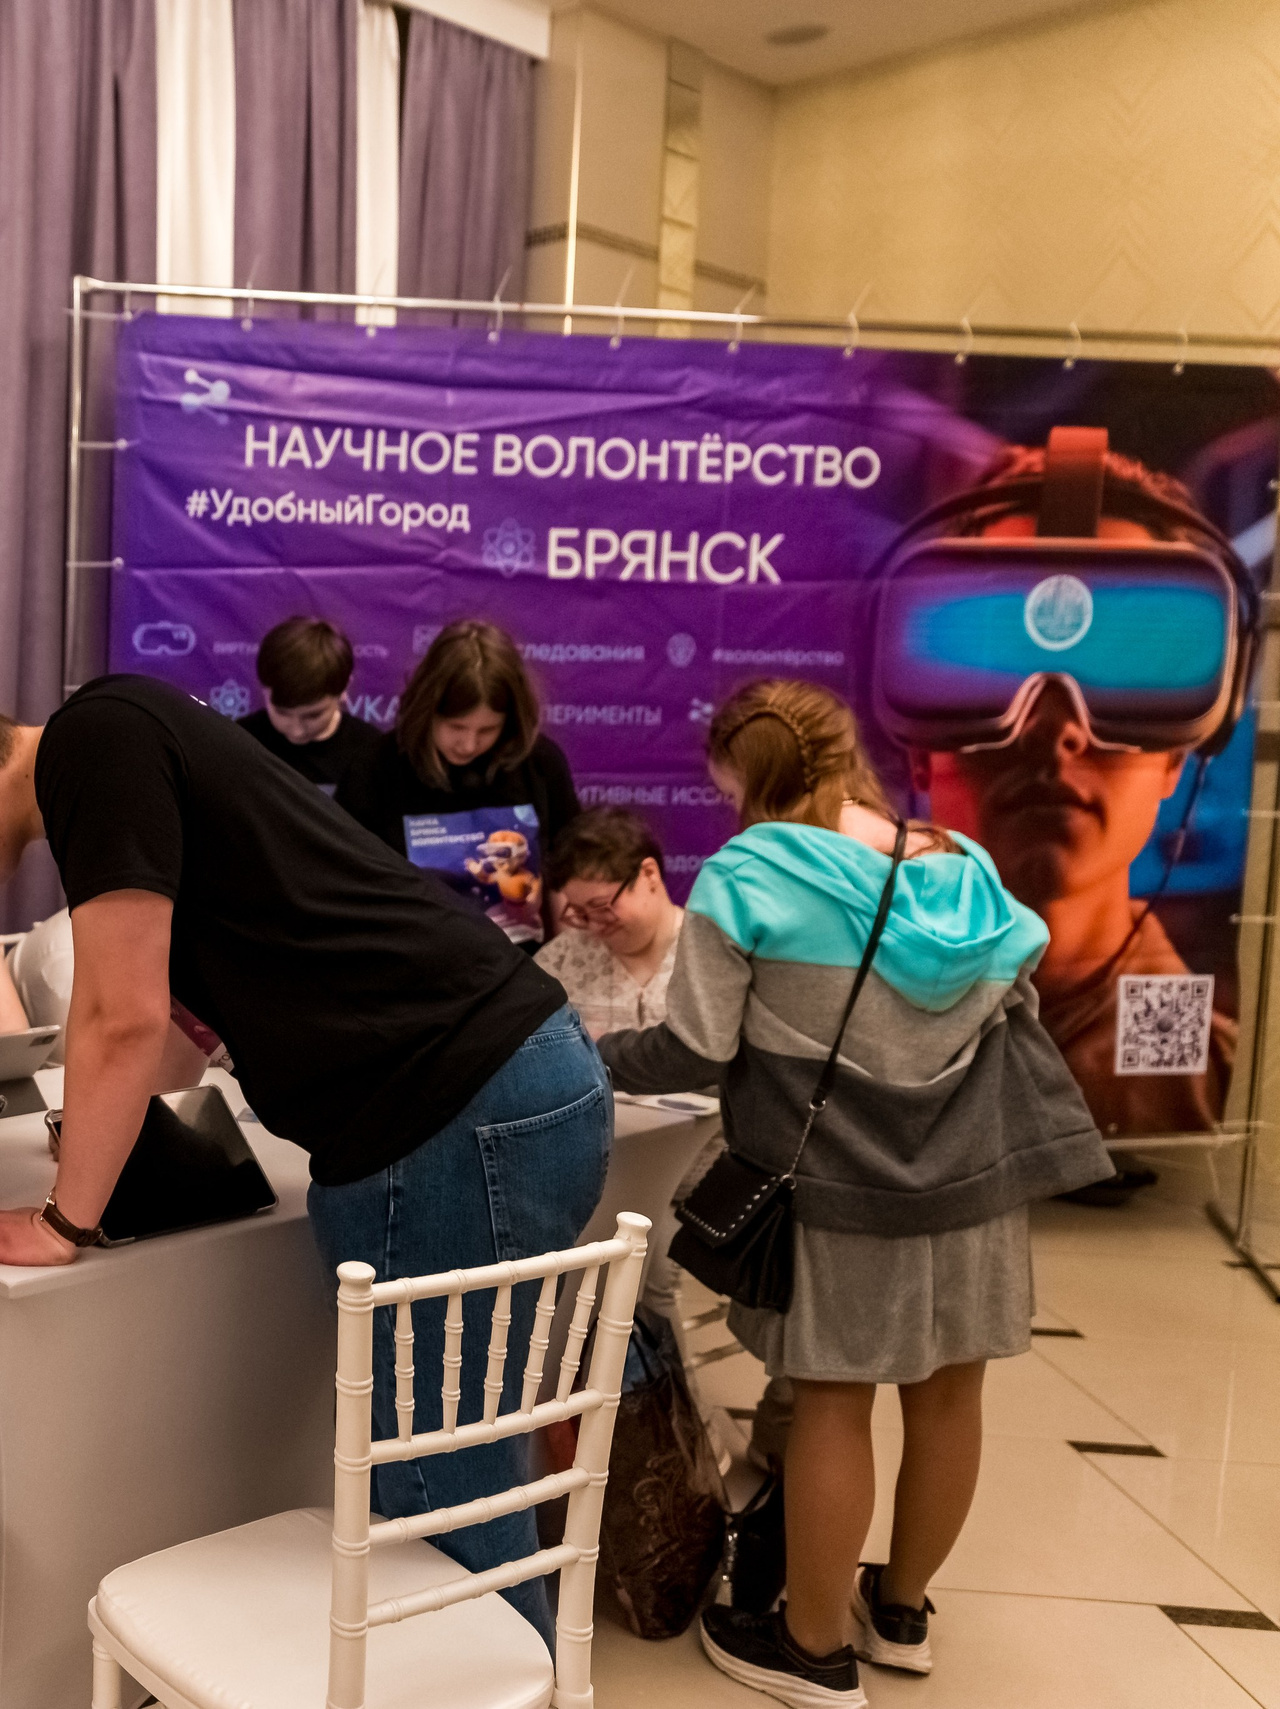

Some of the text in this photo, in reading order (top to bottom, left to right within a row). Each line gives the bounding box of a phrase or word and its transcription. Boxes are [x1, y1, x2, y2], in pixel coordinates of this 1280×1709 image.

[244, 424, 882, 489] НАУЧНОЕ ВОЛОНТЁРСТВО
[185, 490, 471, 534] #УдобныйГород
[547, 528, 786, 585] БРЯНСК
[542, 704, 662, 726] ПЕРИМЕНТЫ
